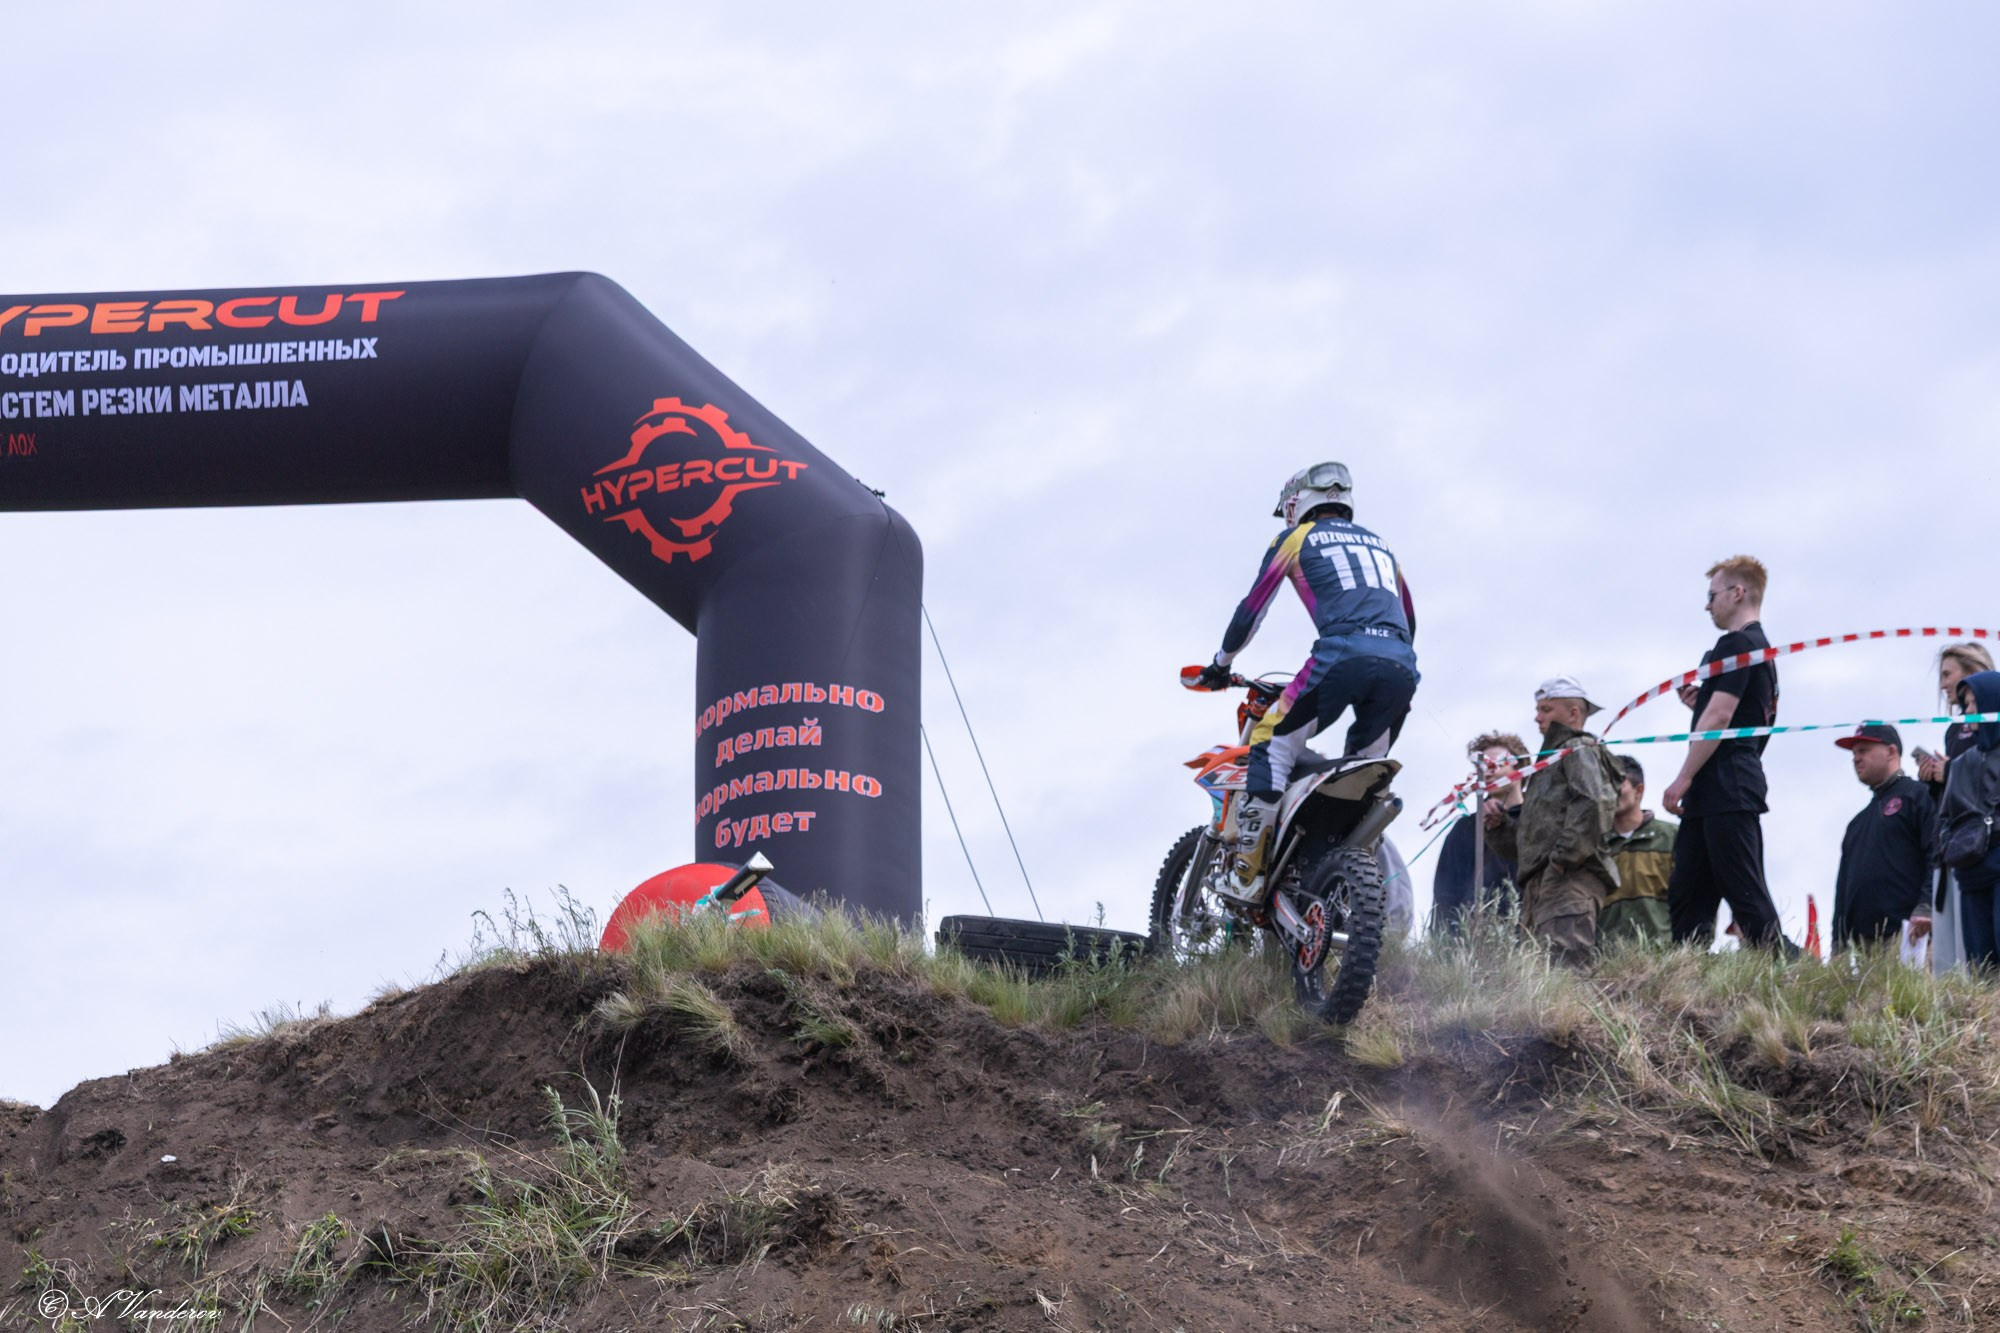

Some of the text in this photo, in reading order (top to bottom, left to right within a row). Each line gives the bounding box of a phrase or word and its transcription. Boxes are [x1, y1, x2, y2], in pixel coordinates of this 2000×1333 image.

[1, 337, 379, 378] ОДИТЕЛЬ ПРОМЫШЛЕННЫХ
[0, 379, 310, 419] СТЕМ РЕЗКИ МЕТАЛЛА
[580, 457, 809, 515] HYPERCUT
[1307, 531, 1393, 553] POZDNYAKO
[715, 717, 822, 768] делай
[715, 811, 816, 848] будет
